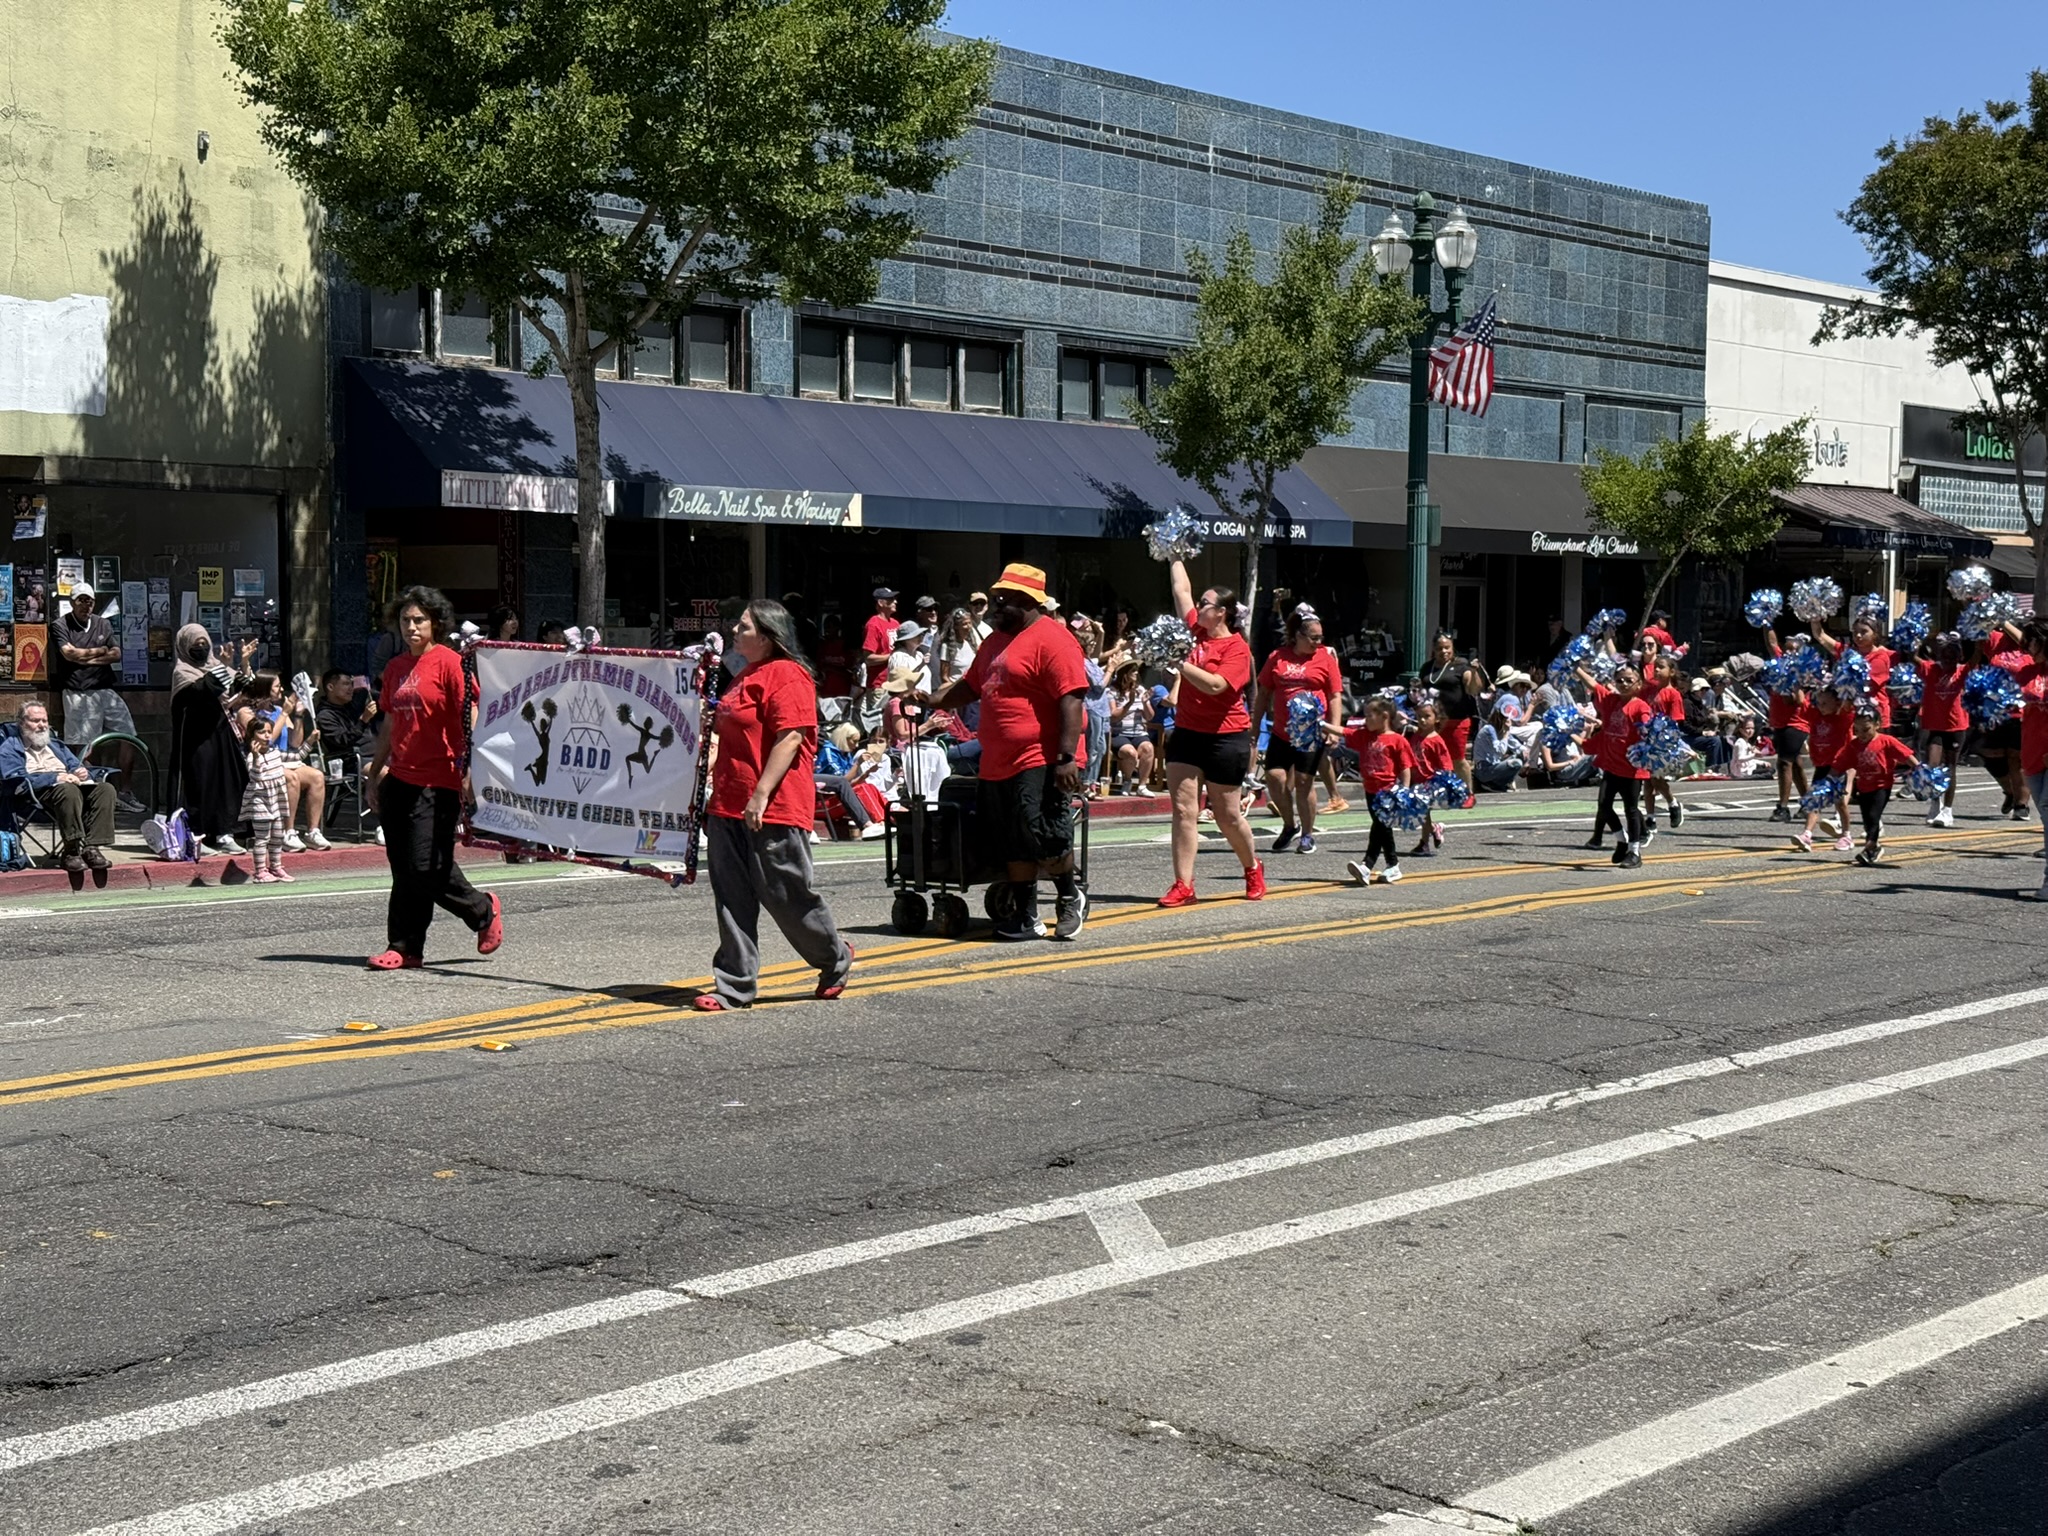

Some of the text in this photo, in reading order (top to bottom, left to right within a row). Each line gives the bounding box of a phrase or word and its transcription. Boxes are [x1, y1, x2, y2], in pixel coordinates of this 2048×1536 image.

[449, 477, 502, 506] LITTLE
[668, 487, 842, 525] Bella Nail Spa & Waxing
[1264, 523, 1286, 538] NAIL
[1289, 524, 1307, 539] SPA
[1531, 530, 1639, 558] Triumphant Life Church
[202, 570, 220, 578] IMP
[690, 598, 720, 617] TK
[673, 618, 702, 632] BARBER
[1349, 658, 1384, 669] Wednesday
[1359, 670, 1375, 681] 7 pm
[675, 667, 699, 695] 154
[484, 658, 697, 755] BAY AREA DYNAMIC DIAMONDS
[560, 744, 611, 770] BADD
[582, 803, 636, 827] CHEER
[638, 809, 690, 832] TEAM
